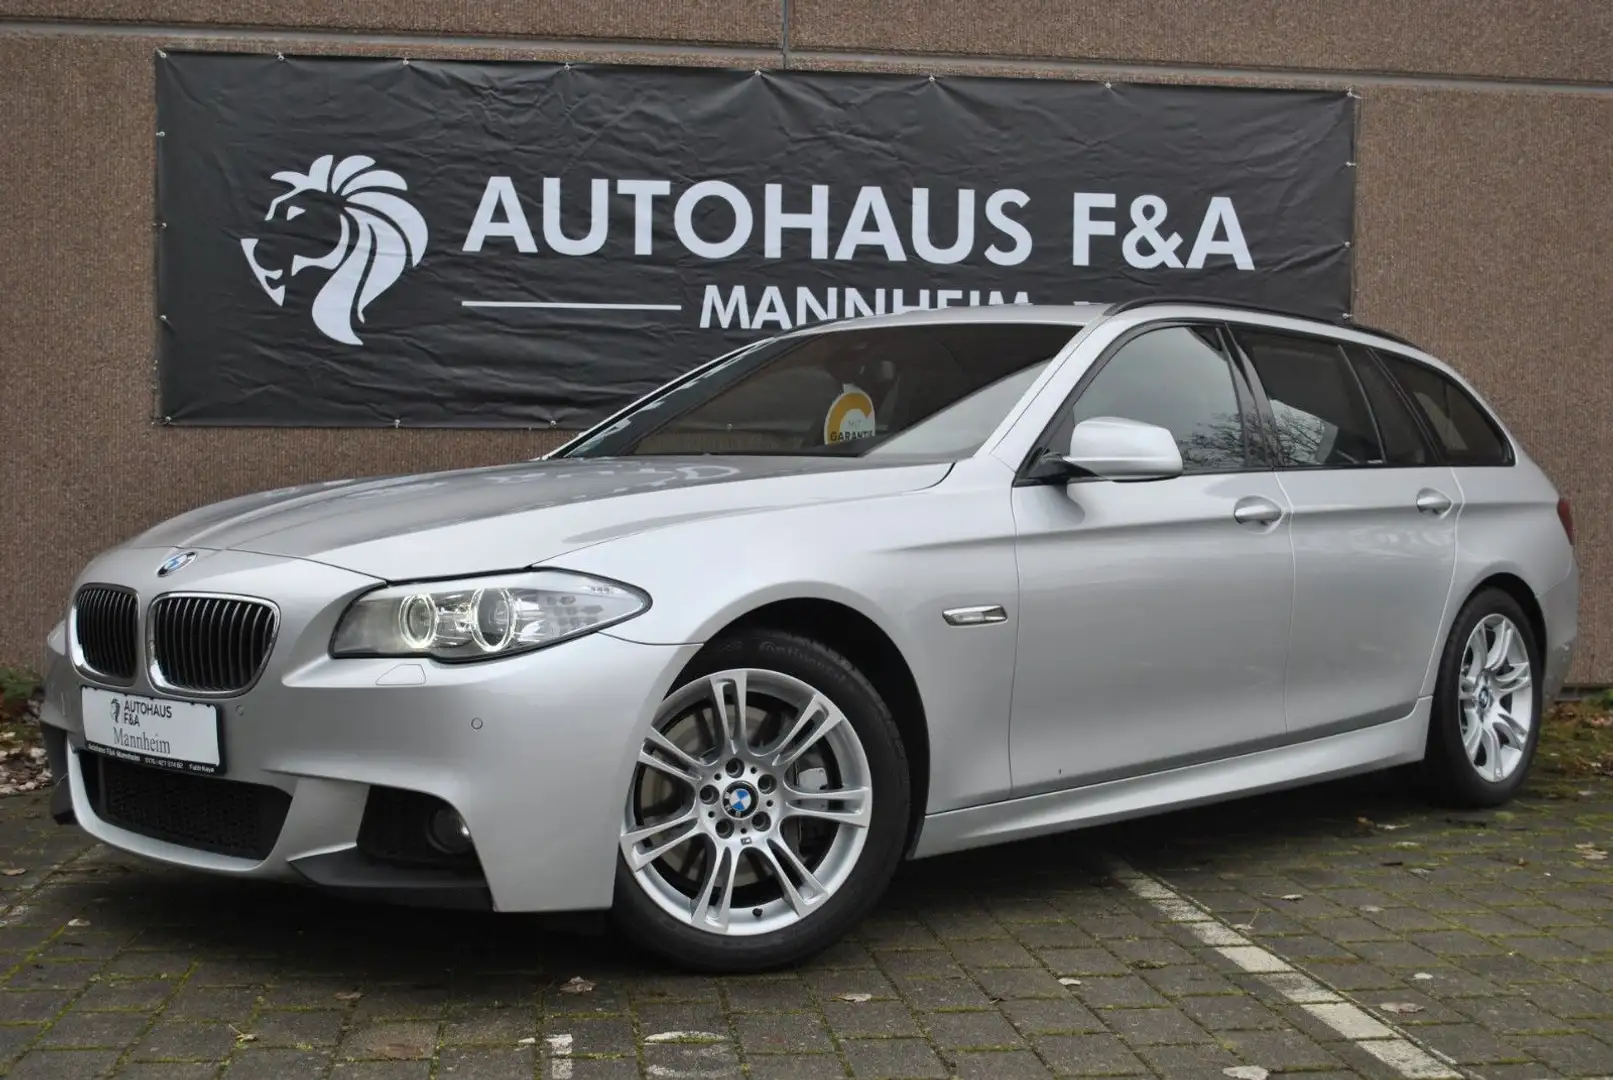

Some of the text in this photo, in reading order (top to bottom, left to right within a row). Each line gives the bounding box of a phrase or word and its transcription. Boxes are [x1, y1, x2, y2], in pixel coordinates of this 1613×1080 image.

[462, 175, 1256, 271] AUTOHAUS F&A
[123, 699, 173, 719] AUTOHAUS
[123, 712, 141, 728] F&A
[112, 726, 171, 754] Mannheim
